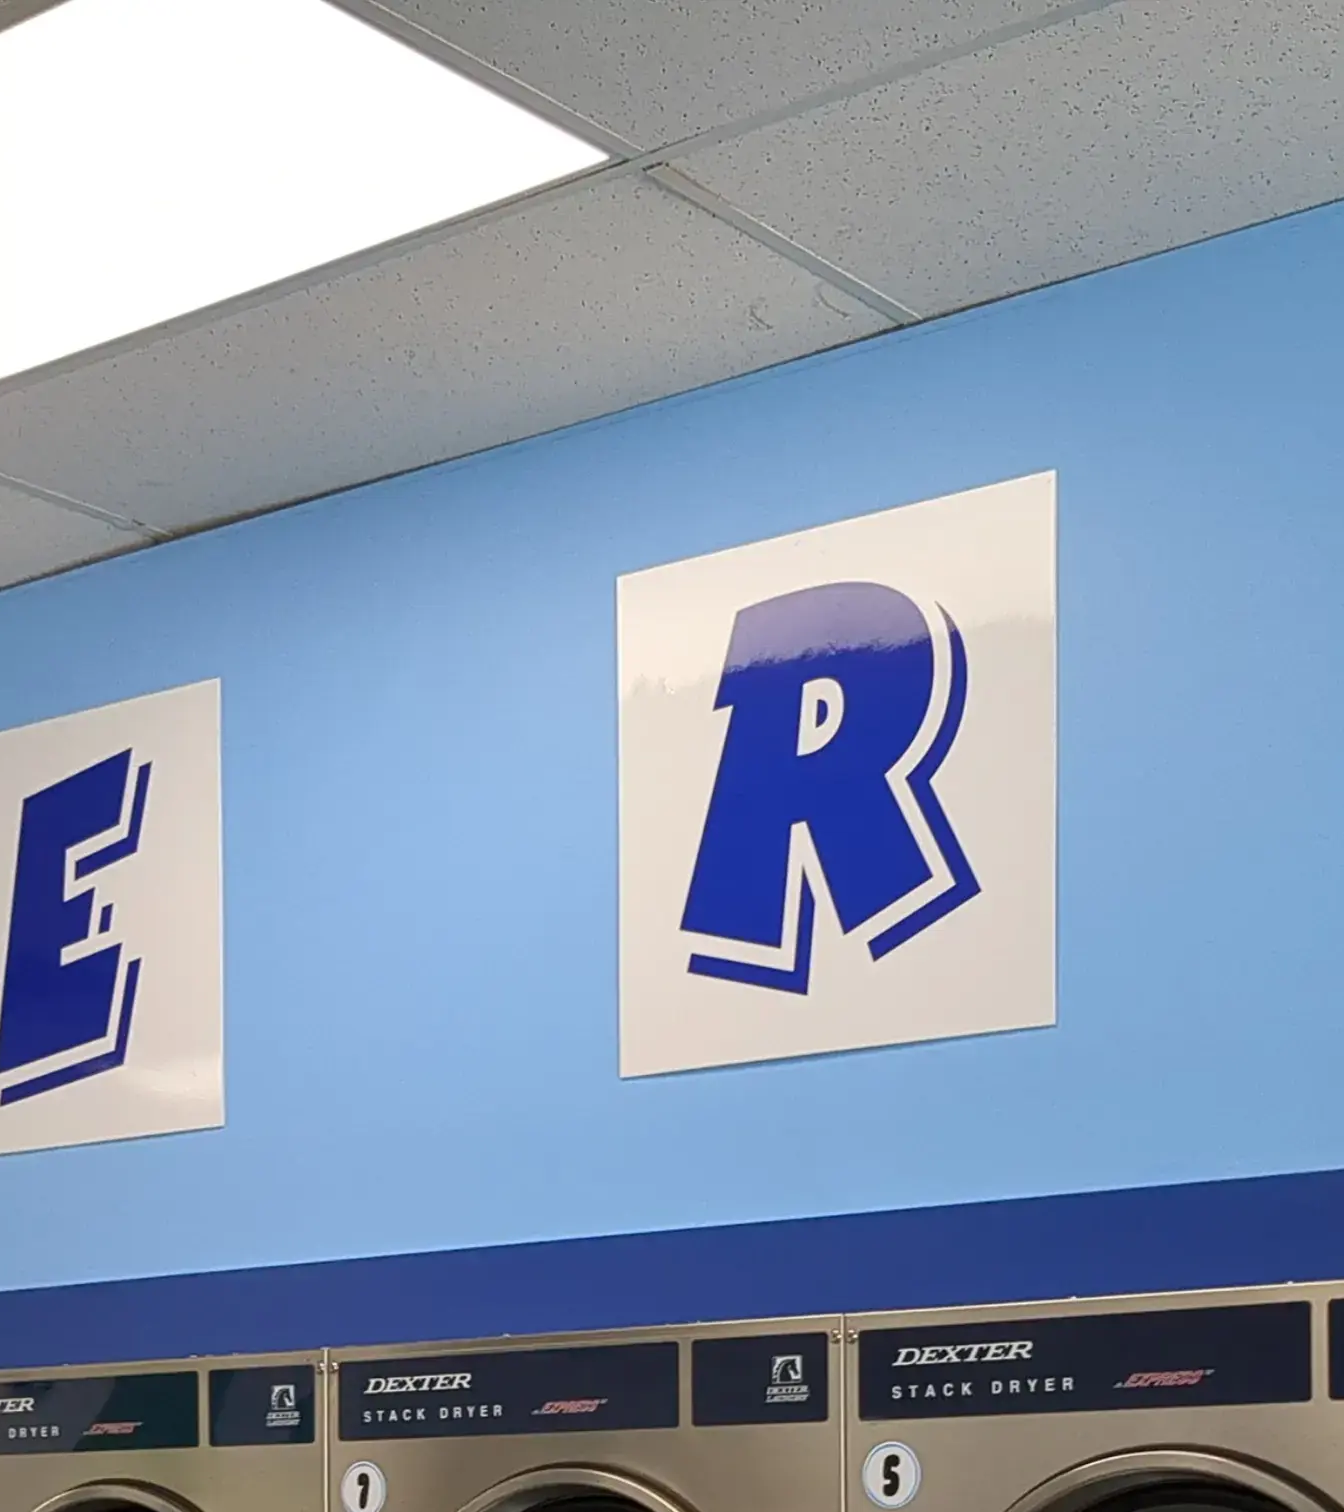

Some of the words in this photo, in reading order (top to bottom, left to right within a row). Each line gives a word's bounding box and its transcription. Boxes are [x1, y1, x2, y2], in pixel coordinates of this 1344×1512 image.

[892, 1340, 1033, 1367] DEXTER
[363, 1373, 472, 1395] DEXTER
[891, 1382, 973, 1400] STACK
[991, 1377, 1075, 1395] DRYER
[363, 1406, 426, 1423] STACK
[440, 1404, 504, 1420] DRYER
[8, 1425, 60, 1439] DRYER
[882, 1454, 901, 1497] 5
[357, 1473, 369, 1509] 7
